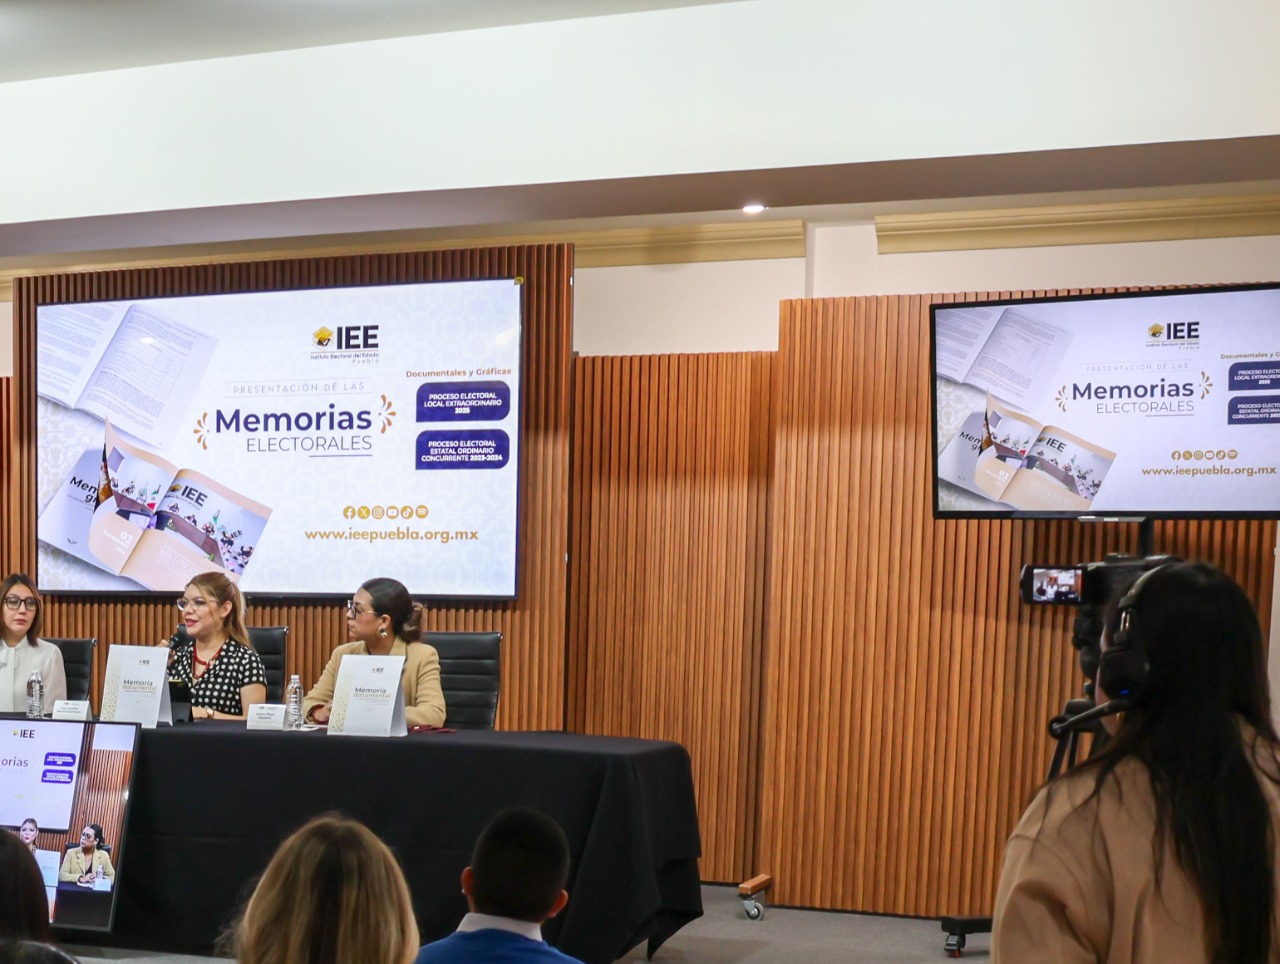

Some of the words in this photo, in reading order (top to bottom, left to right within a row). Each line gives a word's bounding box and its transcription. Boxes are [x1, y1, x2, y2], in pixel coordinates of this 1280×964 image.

[1166, 321, 1200, 340] IEE
[336, 325, 379, 350] IEE
[406, 369, 467, 378] Documentales
[468, 369, 474, 377] y
[476, 367, 511, 376] Gráficas
[1172, 362, 1189, 370] LAS
[233, 382, 318, 395] PRESENTACIÓN
[324, 382, 338, 392] DE
[344, 381, 365, 391] LAS
[1072, 378, 1194, 400] Memorias
[460, 392, 497, 400] ELECTORAL
[423, 400, 445, 408] LOCAL
[445, 399, 502, 407] EXTRAORDINARIO
[1096, 401, 1194, 414] ELECTORALES
[216, 403, 372, 433] Memorias
[247, 435, 372, 452] ELECTORALES
[428, 440, 458, 448] PROCESO
[459, 439, 496, 447] ELECTORAL
[1046, 437, 1067, 453] IEE
[430, 447, 456, 455] ESTATAL
[421, 454, 469, 462] CONCURRENTE
[1141, 465, 1277, 477] www.ieepuebla.org.mx
[181, 485, 208, 507] IEE
[305, 526, 479, 543] www.ieepuebla.org.mx
[20, 729, 35, 739] IEE
